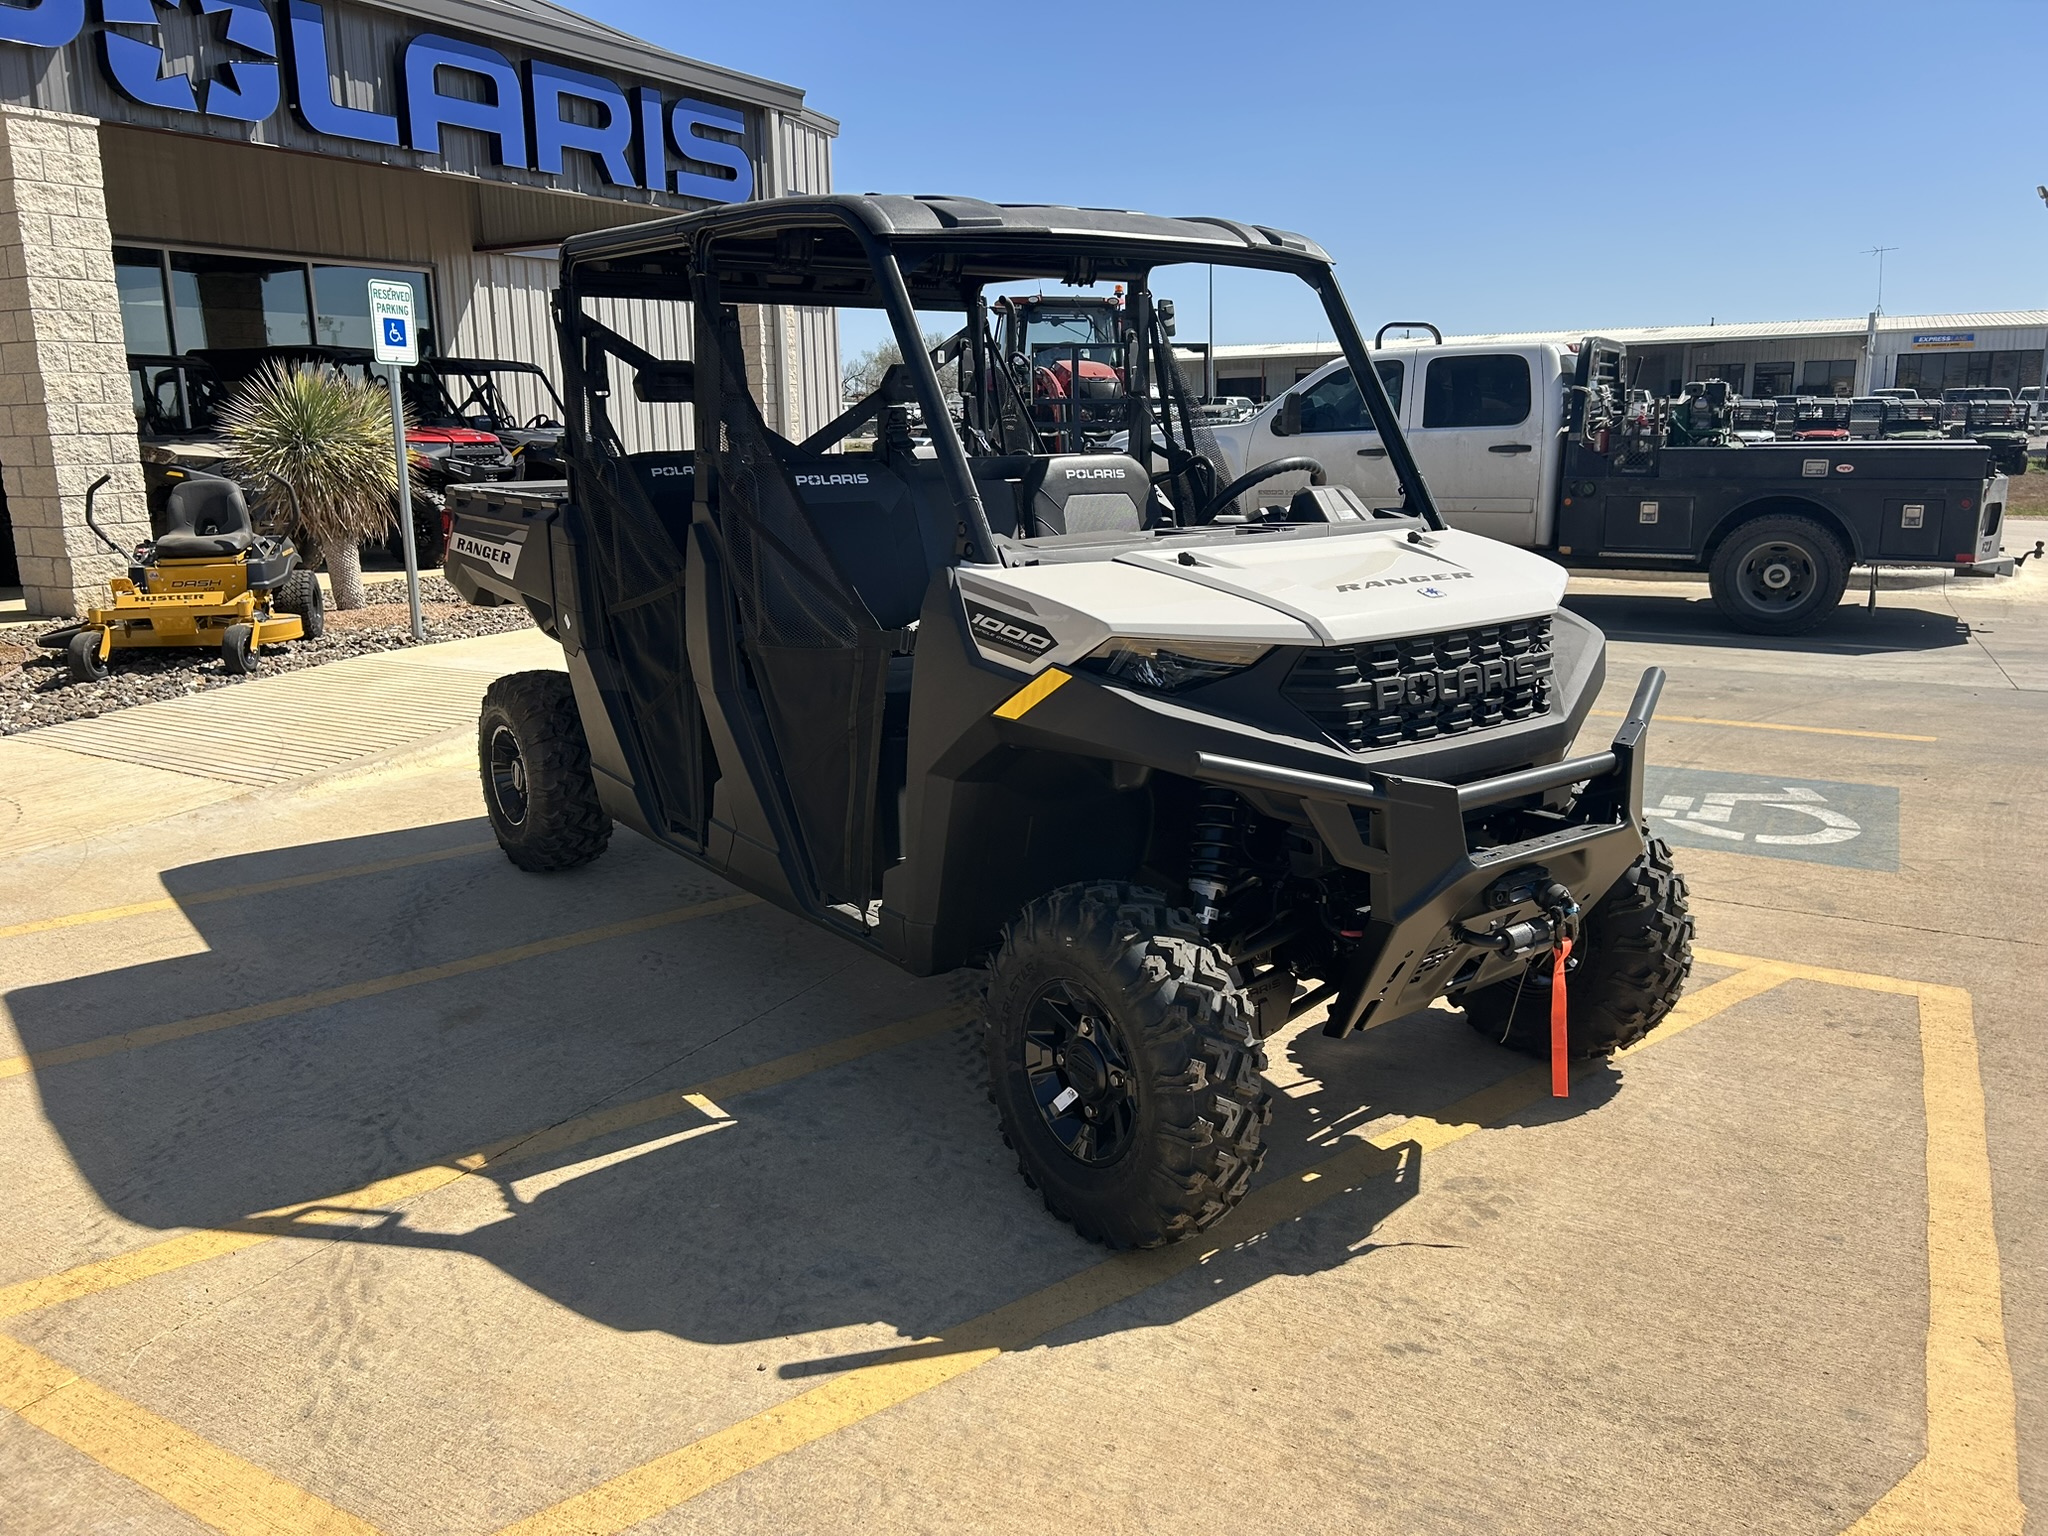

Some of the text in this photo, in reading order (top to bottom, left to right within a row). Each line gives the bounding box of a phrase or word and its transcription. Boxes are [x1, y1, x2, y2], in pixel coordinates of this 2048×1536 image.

[372, 288, 411, 302] RESERVED
[376, 302, 409, 316] PARKING
[1918, 335, 1951, 343] EXPRESS
[651, 466, 696, 477] POLA
[1065, 468, 1126, 479] POLARIS
[795, 473, 869, 486] POLARIS
[457, 537, 511, 565] RANGER
[171, 579, 222, 588] DASH
[1336, 572, 1474, 593] RANGER
[134, 594, 205, 603] HUSTLER
[971, 613, 1051, 649] 1000
[1372, 654, 1537, 710] POLARIS
